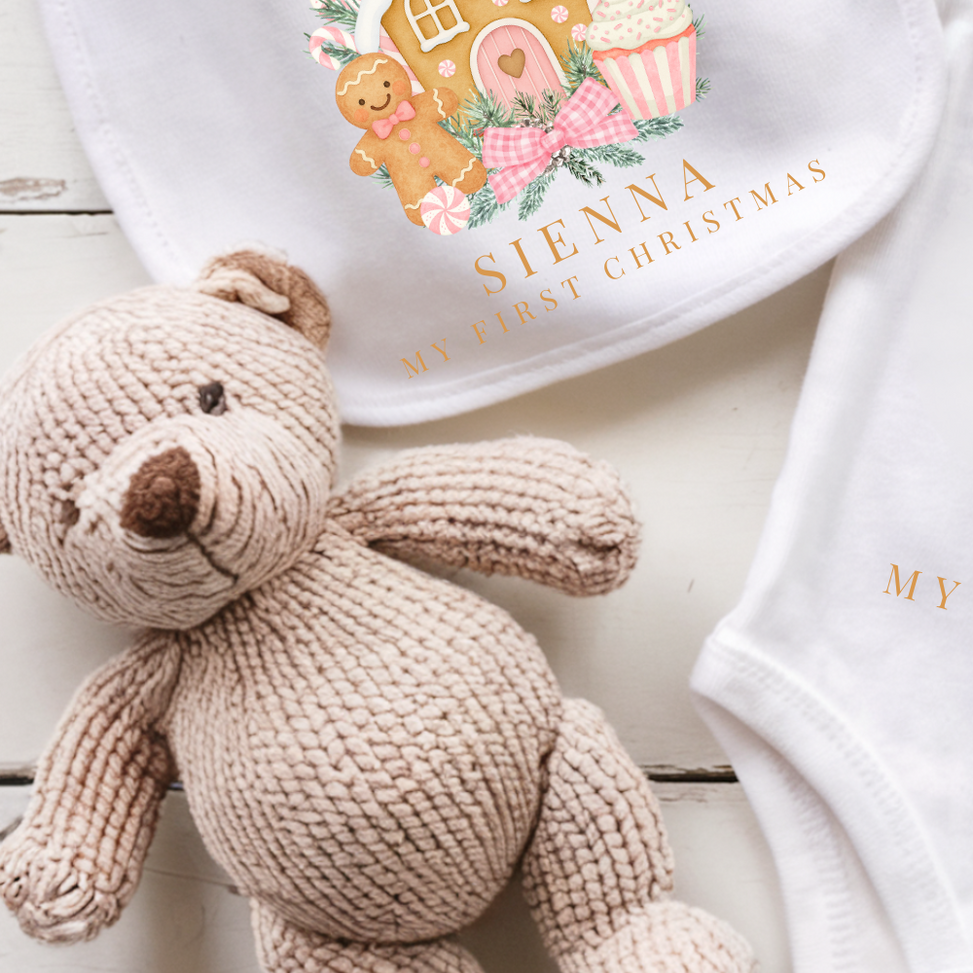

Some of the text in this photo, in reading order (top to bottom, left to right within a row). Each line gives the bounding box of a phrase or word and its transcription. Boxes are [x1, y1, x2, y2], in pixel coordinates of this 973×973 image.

[400, 158, 827, 379] MY FIRST CHRISTMAS
[473, 158, 716, 297] SIENNA
[882, 563, 962, 611] MY
